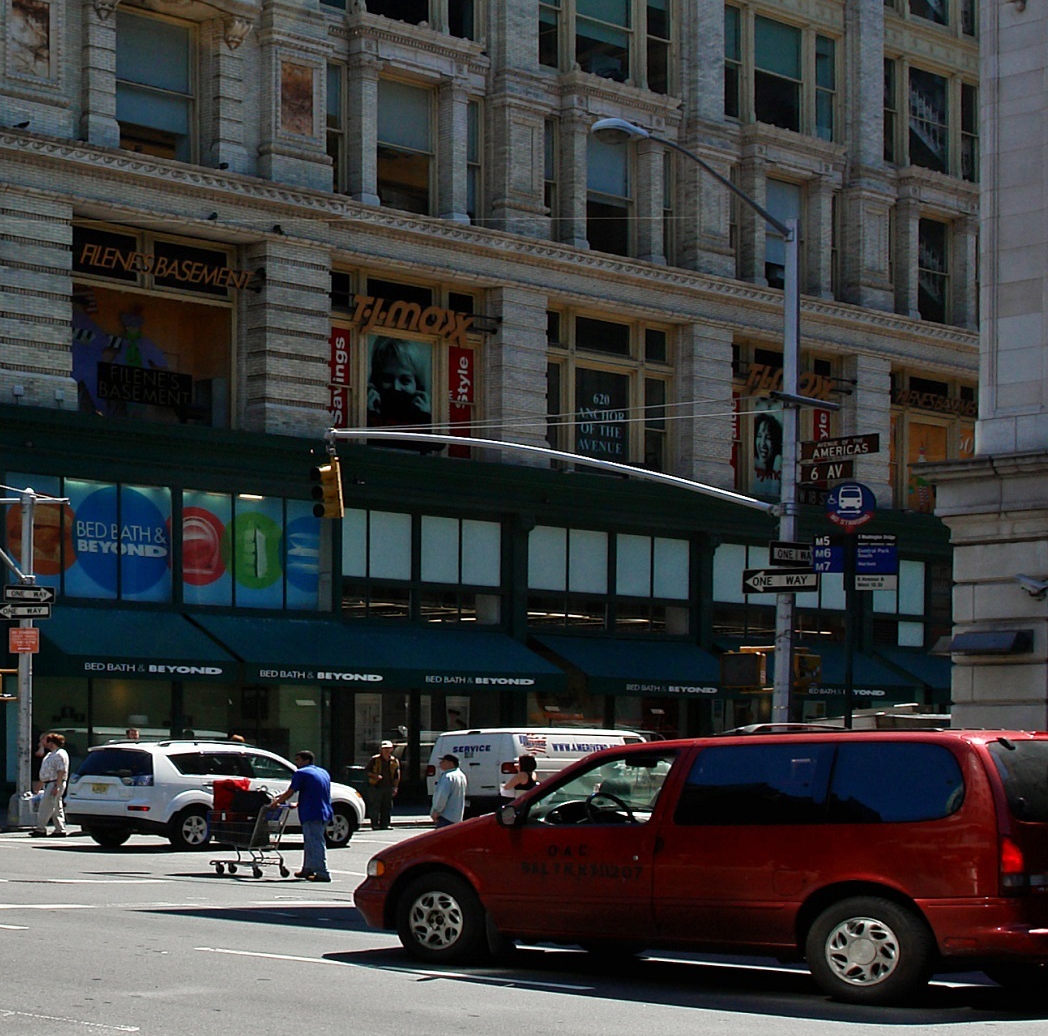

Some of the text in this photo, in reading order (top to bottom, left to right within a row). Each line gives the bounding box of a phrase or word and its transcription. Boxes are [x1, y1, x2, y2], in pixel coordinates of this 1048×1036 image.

[80, 244, 257, 289] FILENE'S BASEMENT
[110, 365, 180, 390] FILENE'S
[99, 381, 190, 405] BASEMENT
[593, 393, 610, 404] 620
[578, 407, 625, 421] ANCHOR
[580, 423, 622, 439] OF THE
[578, 439, 623, 455] AVENUE
[812, 444, 869, 459] AMERICAS
[811, 464, 843, 480] 6 AV
[77, 521, 167, 544] BED BATH &
[816, 536, 830, 546] M5
[77, 539, 168, 558] BEYOND
[777, 549, 811, 561] ONE WA
[815, 548, 831, 558] M6
[815, 561, 831, 571] M7
[753, 576, 808, 586] ONE WAY
[85, 662, 223, 675] BED BATH & BEYOND
[259, 669, 279, 678] BED
[280, 670, 305, 679] BATH
[317, 671, 383, 682] BEYOND
[425, 675, 442, 683] BED
[443, 676, 466, 684] BATH
[475, 677, 535, 685] BEYOND
[641, 684, 660, 692] BATH
[668, 686, 718, 694] BEYOND
[453, 745, 492, 753] SERVICE
